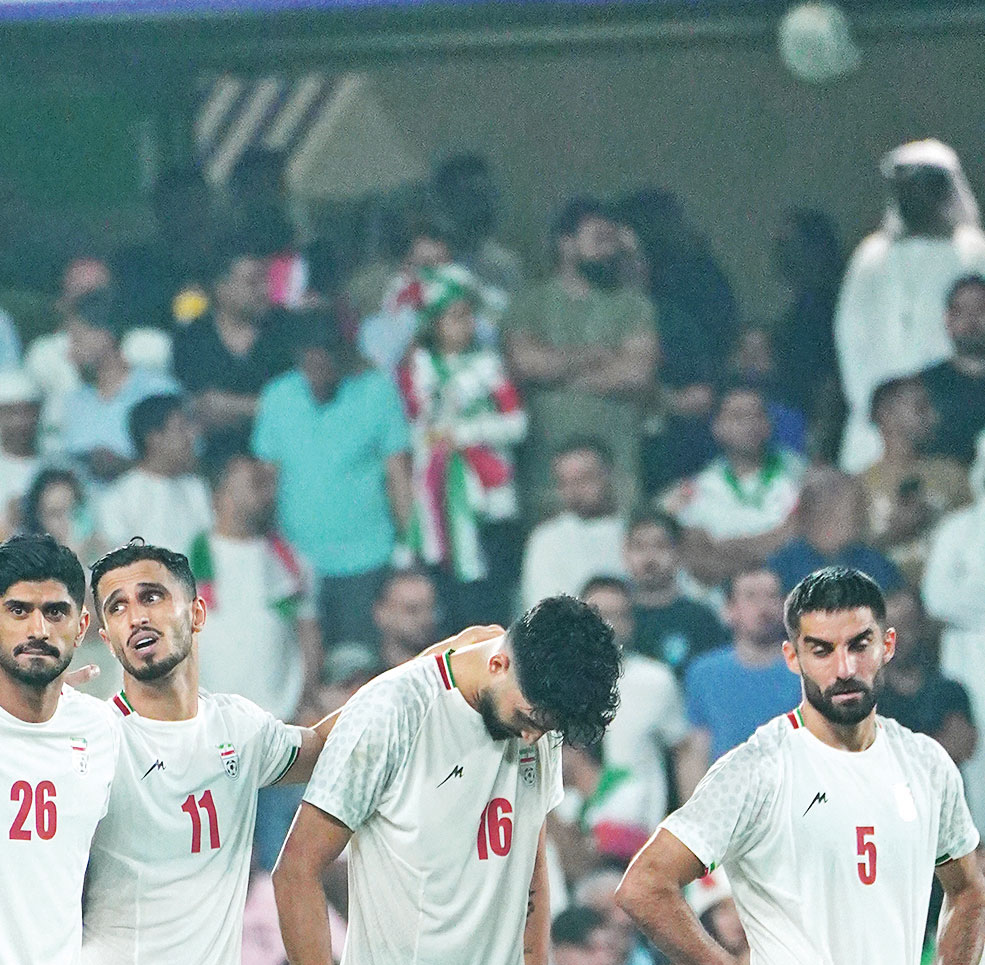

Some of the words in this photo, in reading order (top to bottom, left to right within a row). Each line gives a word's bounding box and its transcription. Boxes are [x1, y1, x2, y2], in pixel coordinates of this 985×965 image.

[9, 780, 57, 841] 26
[181, 789, 220, 853] 11
[477, 797, 513, 860] 16
[855, 826, 877, 886] 5
